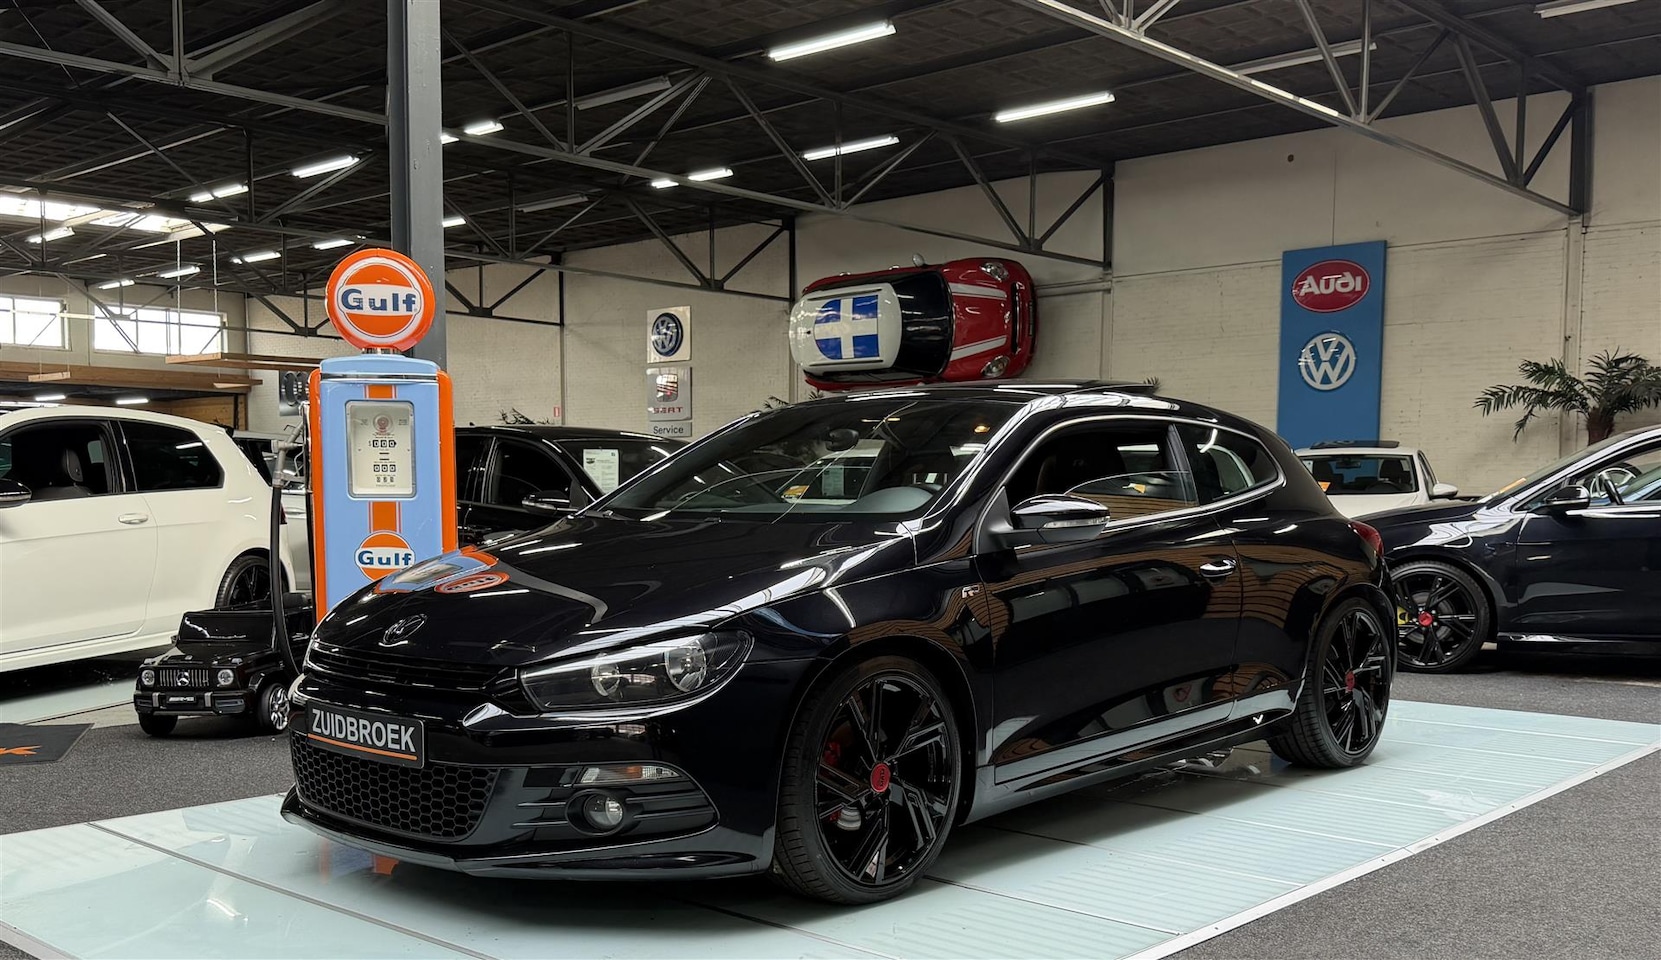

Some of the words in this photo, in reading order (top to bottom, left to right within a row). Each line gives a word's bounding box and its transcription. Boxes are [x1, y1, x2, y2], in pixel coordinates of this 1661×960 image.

[341, 288, 417, 312] Gulf
[653, 424, 684, 434] Service
[357, 550, 412, 566] Gulf
[312, 708, 416, 752] ZUIDBROEK
